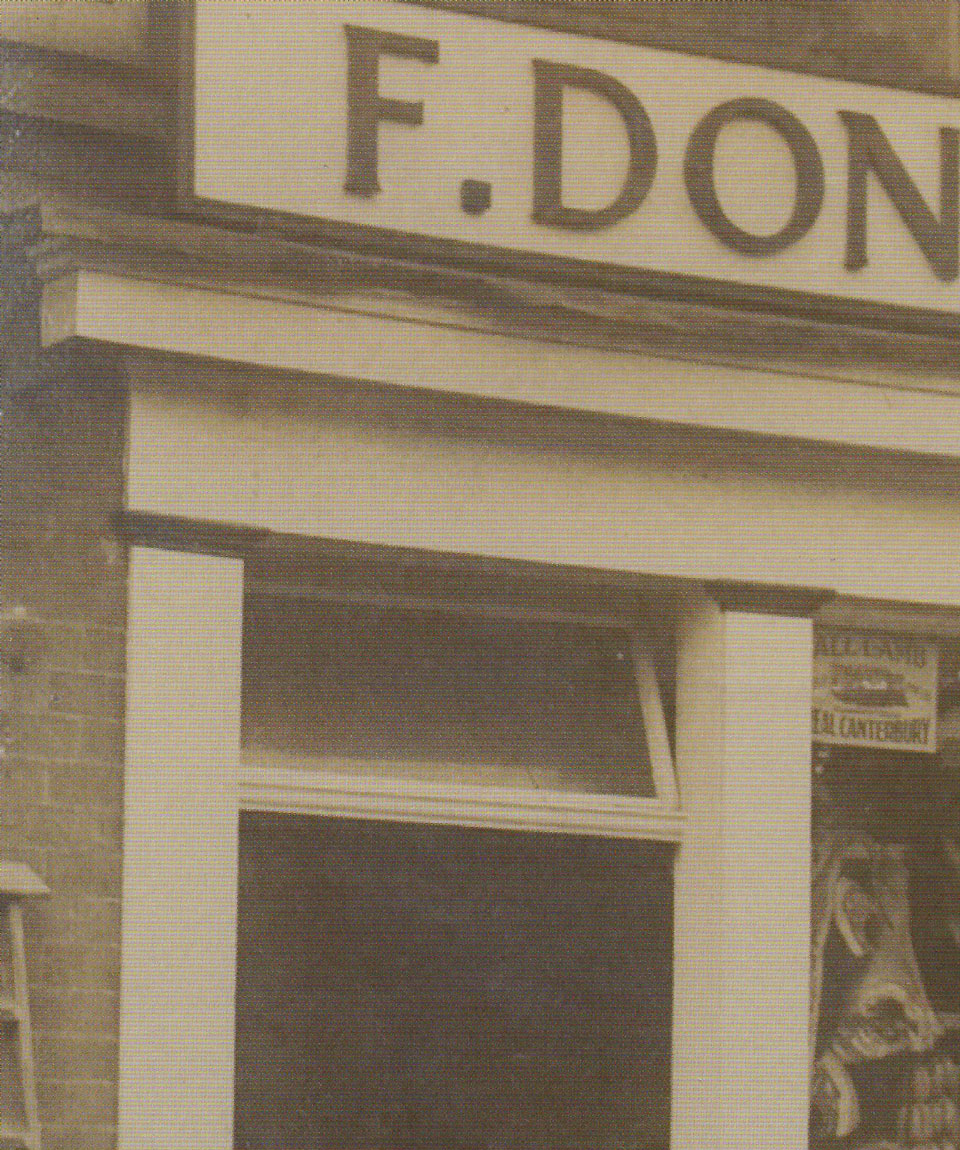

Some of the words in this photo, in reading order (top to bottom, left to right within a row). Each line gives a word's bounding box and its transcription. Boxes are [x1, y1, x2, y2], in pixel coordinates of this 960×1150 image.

[346, 22, 494, 218] F.
[812, 709, 834, 736] EAL
[840, 715, 929, 745] CANTERBURY
